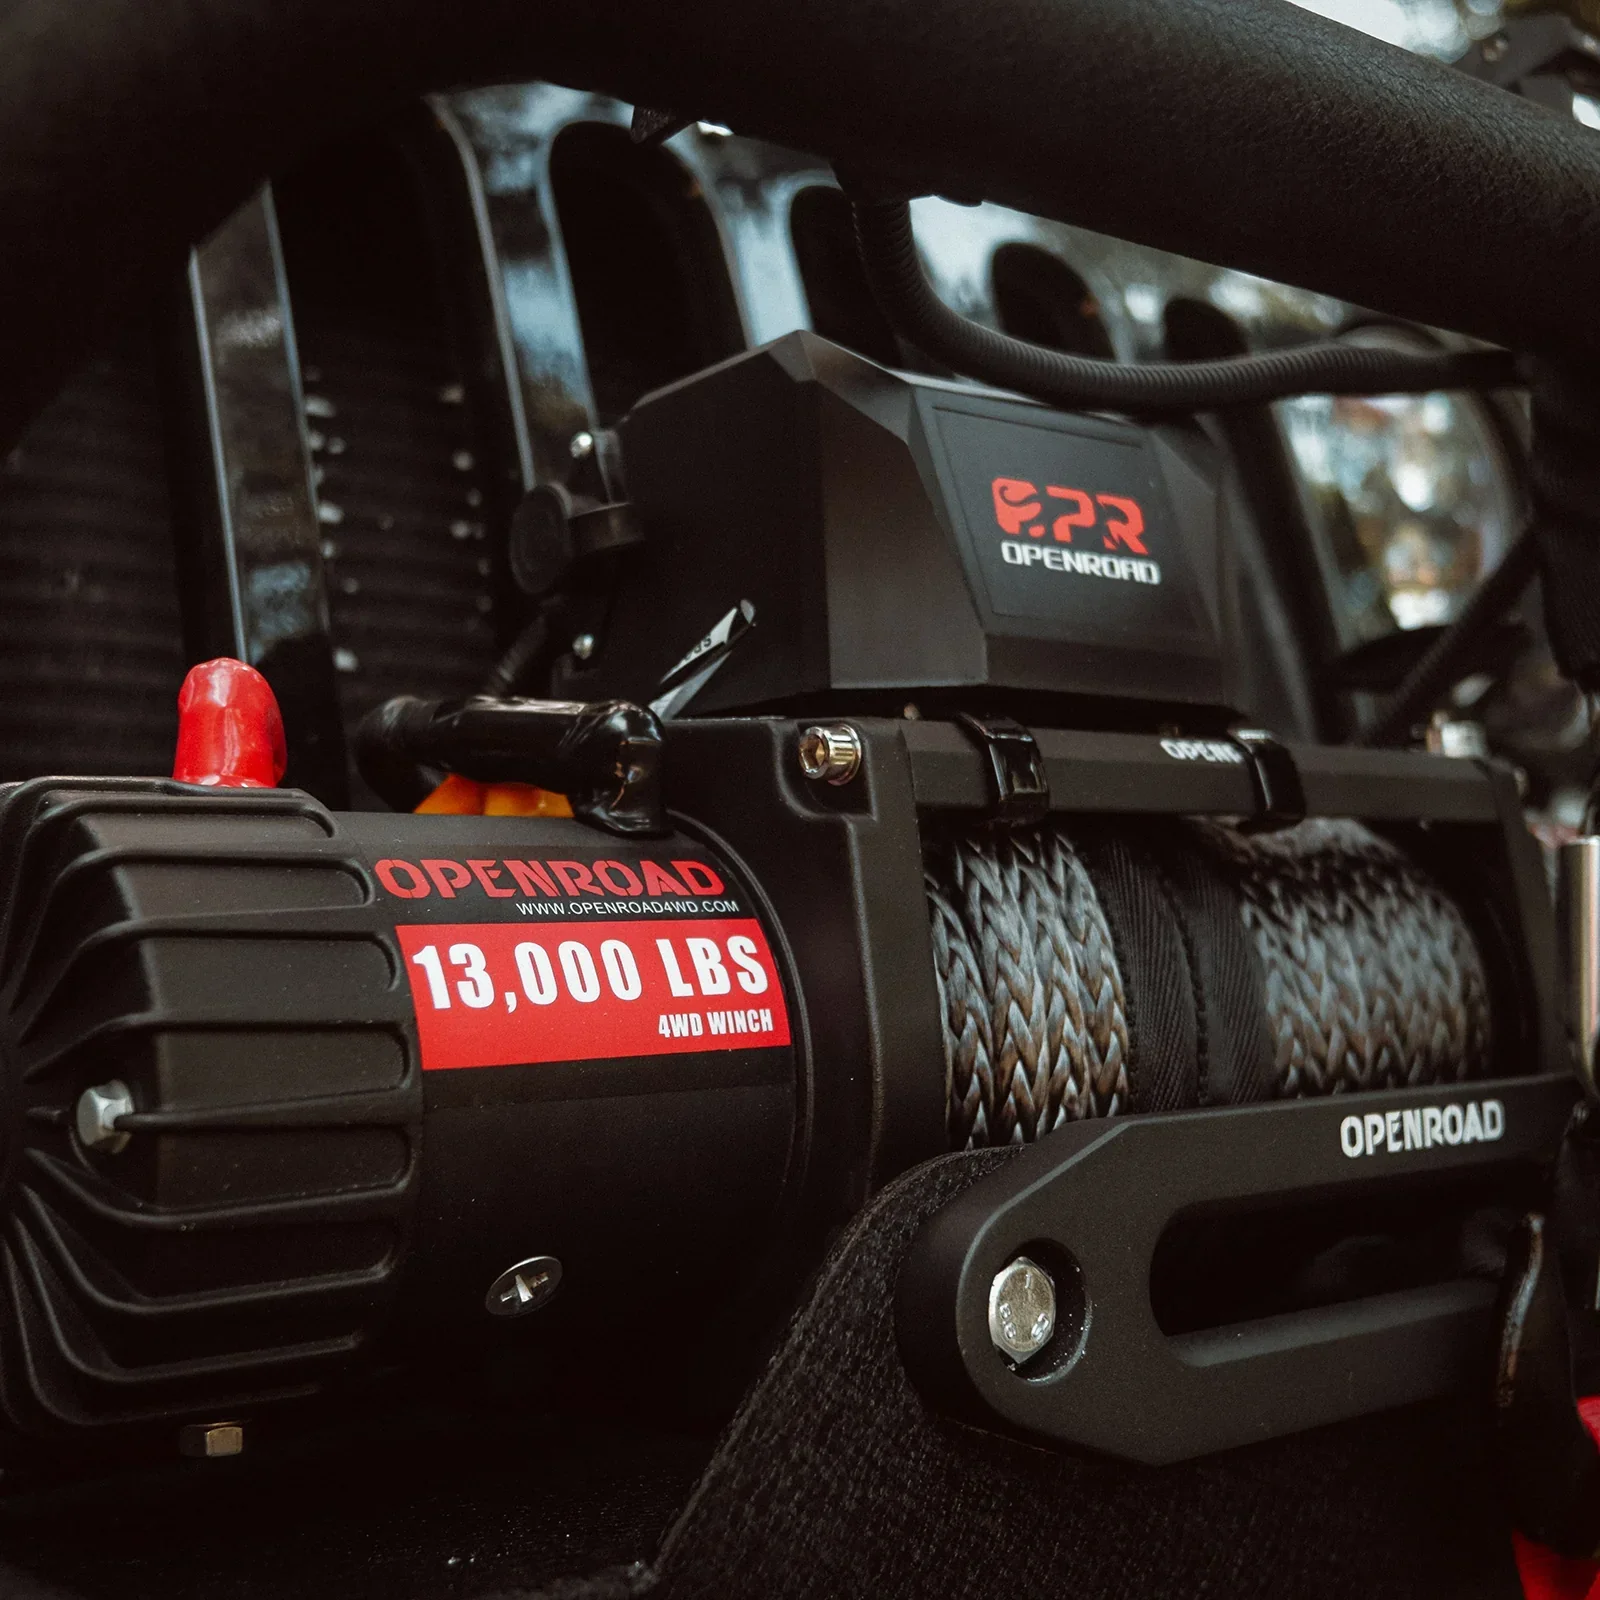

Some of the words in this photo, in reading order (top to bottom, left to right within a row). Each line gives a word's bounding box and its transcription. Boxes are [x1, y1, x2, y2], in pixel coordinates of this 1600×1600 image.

[1000, 539, 1161, 585] OPENROAD
[374, 859, 725, 898] OPENROAD
[515, 901, 739, 916] WWW.OPENROAD4WD.COM
[412, 939, 643, 1013] 13,000
[656, 935, 769, 997] LBS
[658, 1014, 703, 1038] 4WD
[708, 1009, 773, 1035] WINCH
[1340, 1099, 1506, 1159] OPENROAD
